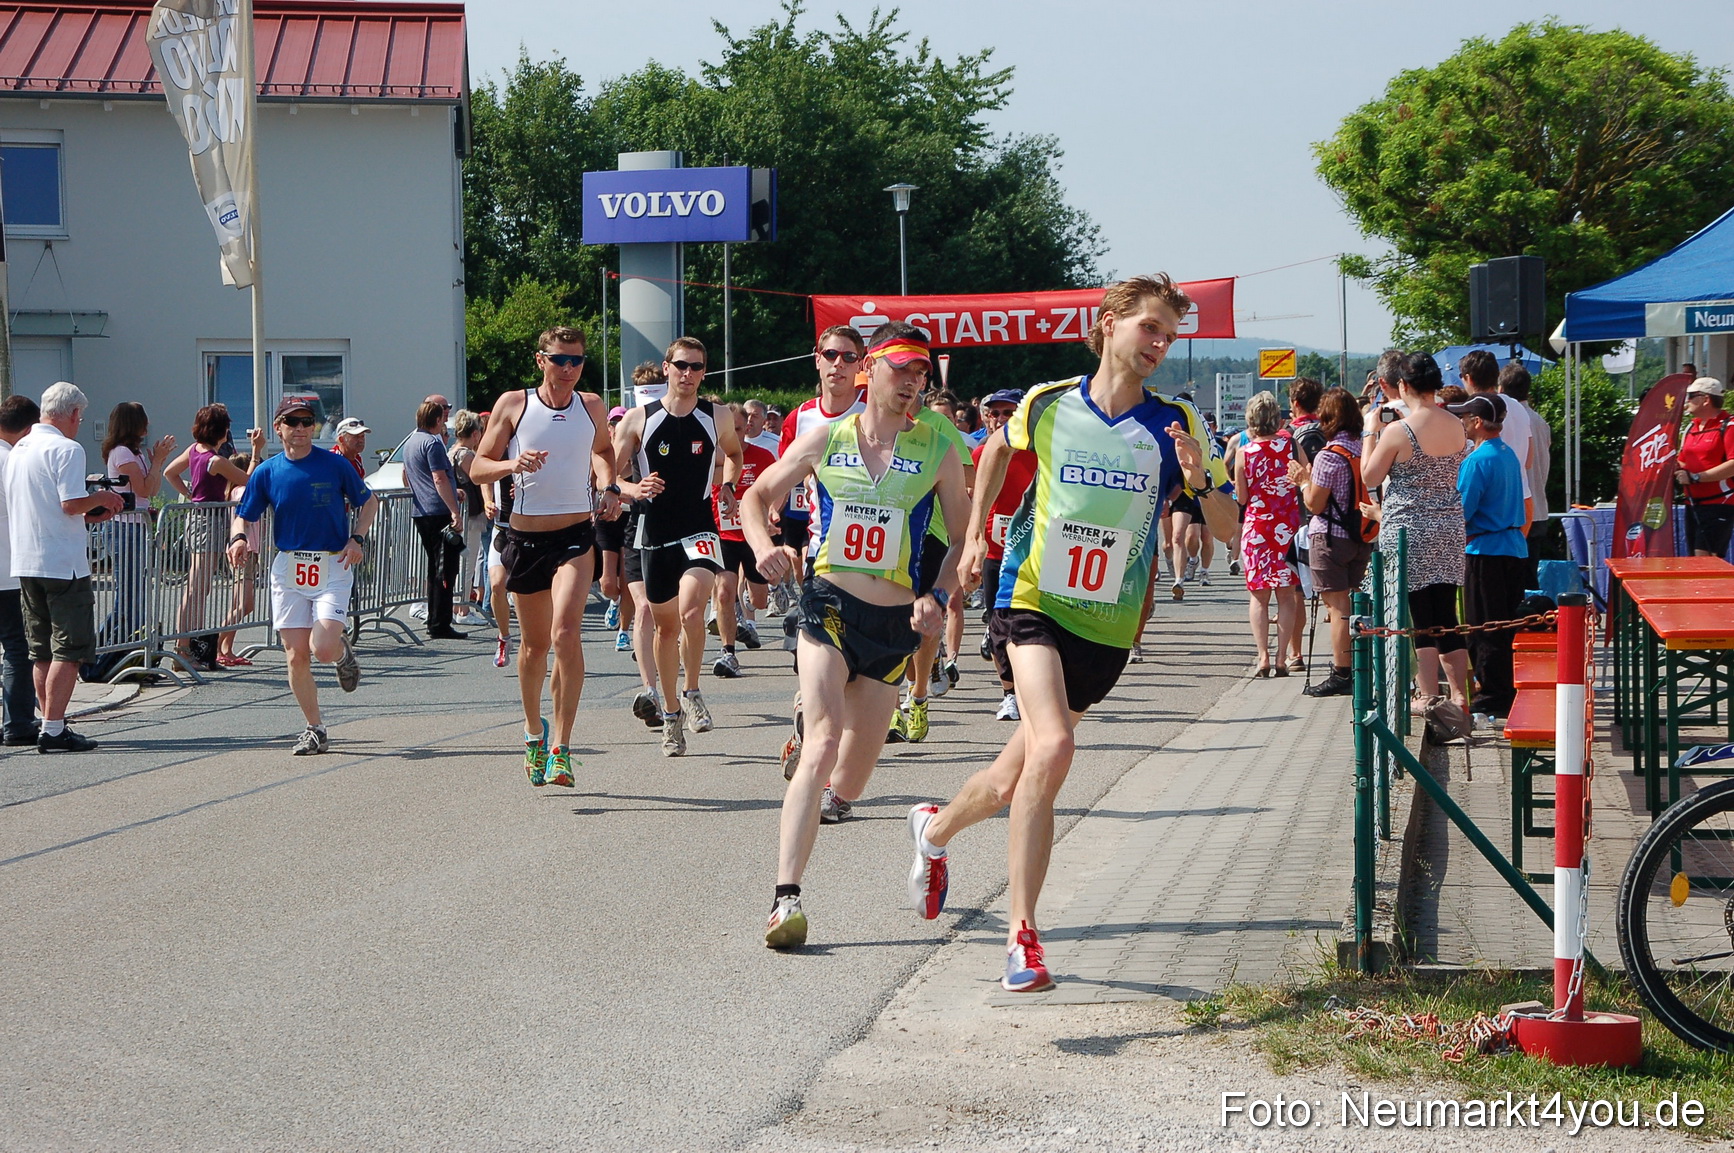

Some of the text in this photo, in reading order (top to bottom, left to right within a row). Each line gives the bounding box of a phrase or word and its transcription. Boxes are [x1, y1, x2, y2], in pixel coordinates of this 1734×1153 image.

[598, 190, 725, 218] VOLVO
[1065, 449, 1121, 468] TEAM
[1061, 465, 1149, 492] BOCK
[844, 513, 877, 521] WERBUNG
[845, 505, 877, 516] MEYER
[1062, 523, 1101, 538] MEYER
[1062, 532, 1100, 545] WERBUNG
[695, 540, 717, 559] 81
[844, 523, 886, 563] 99
[295, 562, 319, 587] 56
[1067, 545, 1108, 592] 10
